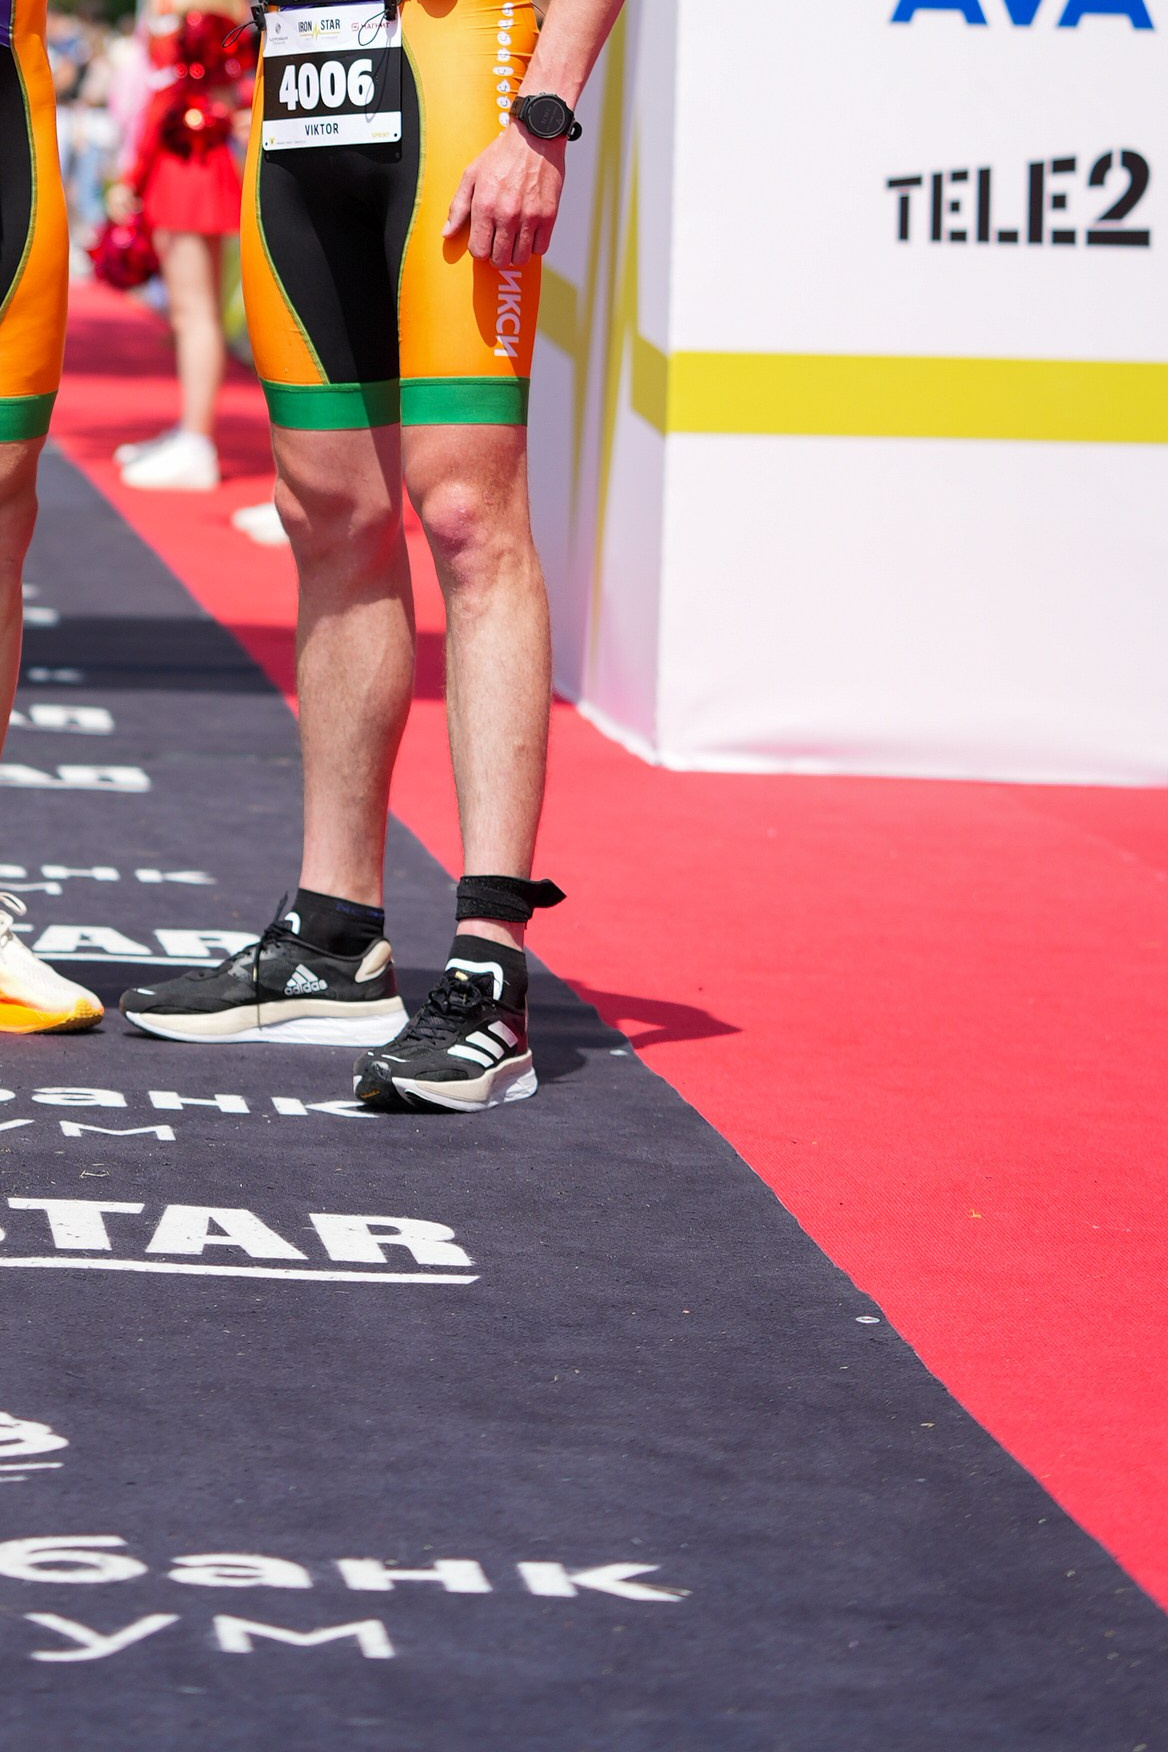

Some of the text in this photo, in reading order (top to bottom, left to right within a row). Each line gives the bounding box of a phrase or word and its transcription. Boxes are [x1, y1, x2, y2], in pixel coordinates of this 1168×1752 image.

[298, 19, 341, 33] IRON STAR
[279, 58, 375, 111] 4006
[304, 123, 339, 136] VIKTOR
[886, 148, 1151, 248] TELE2
[494, 270, 522, 358] ИКСИ
[284, 979, 328, 996] adidas
